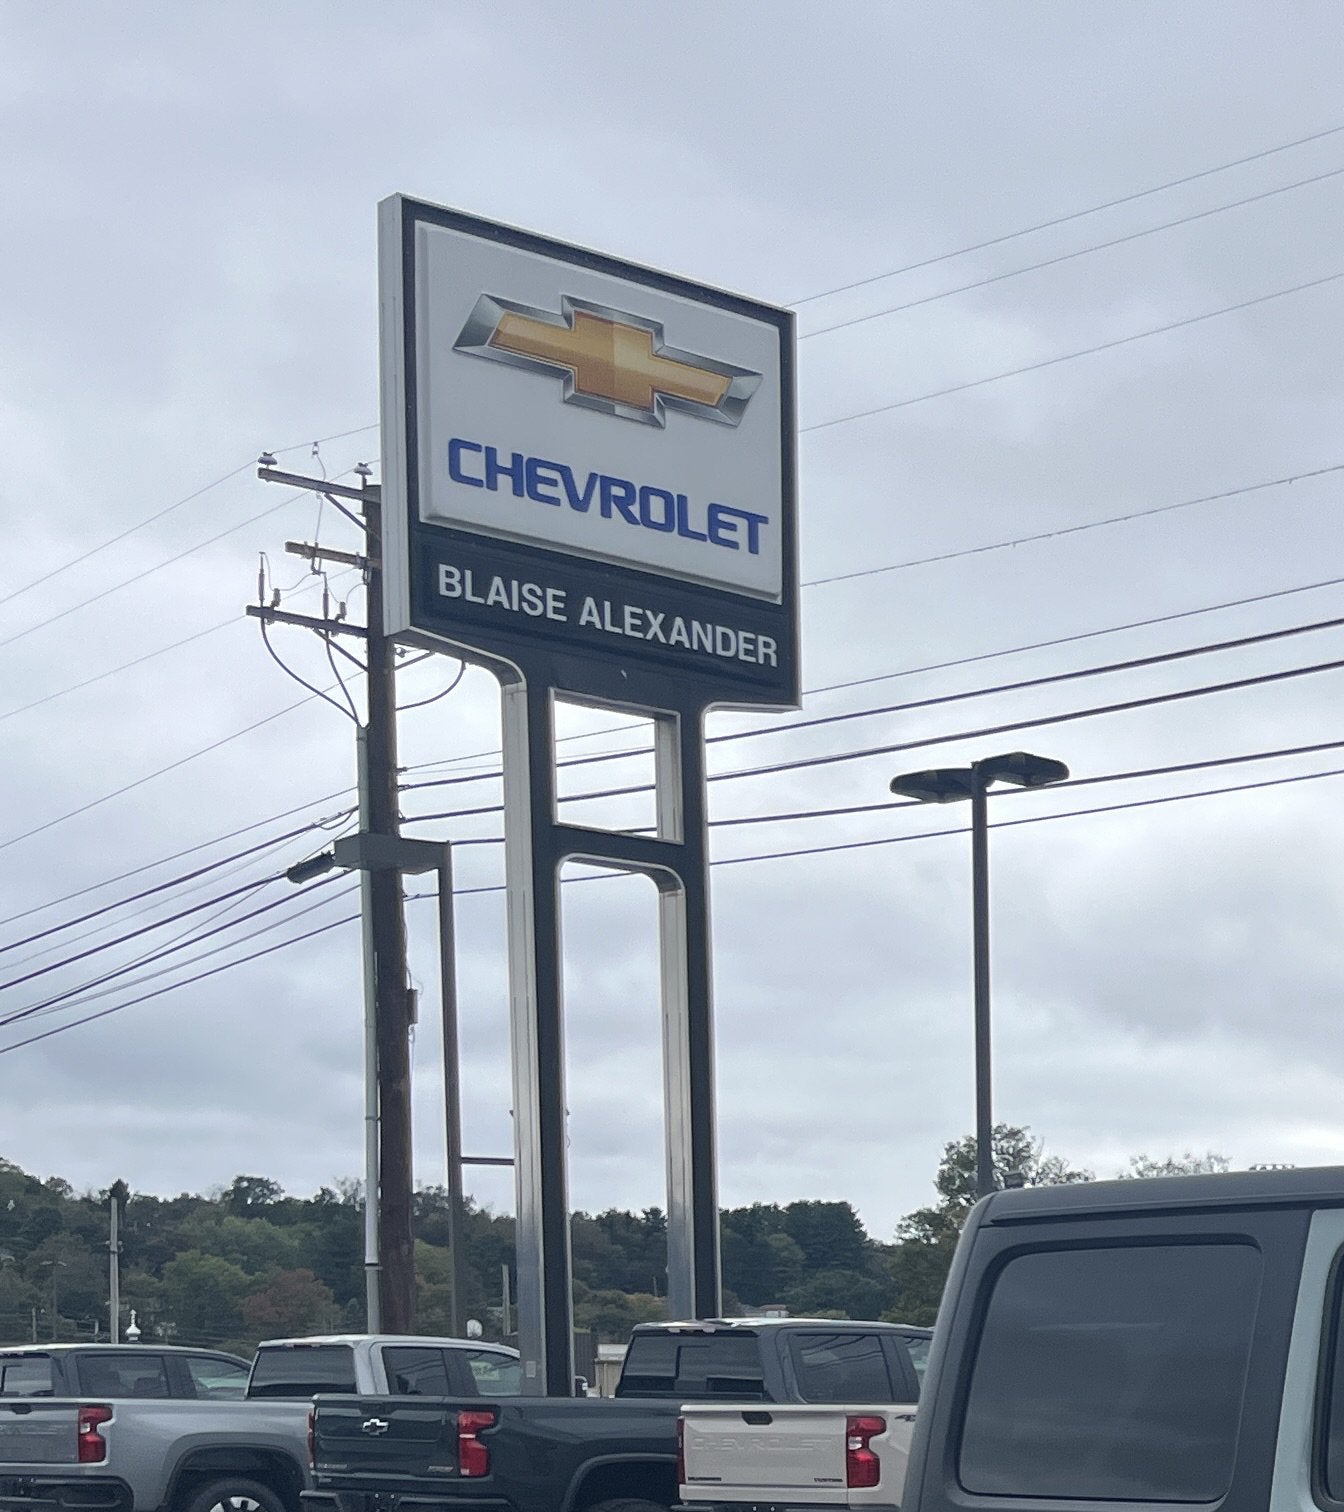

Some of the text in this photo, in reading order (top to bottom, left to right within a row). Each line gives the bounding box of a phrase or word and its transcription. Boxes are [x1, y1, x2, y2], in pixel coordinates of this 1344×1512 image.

[447, 437, 769, 555] CHEVROLET
[438, 563, 779, 668] BLAISE ALEXANDER
